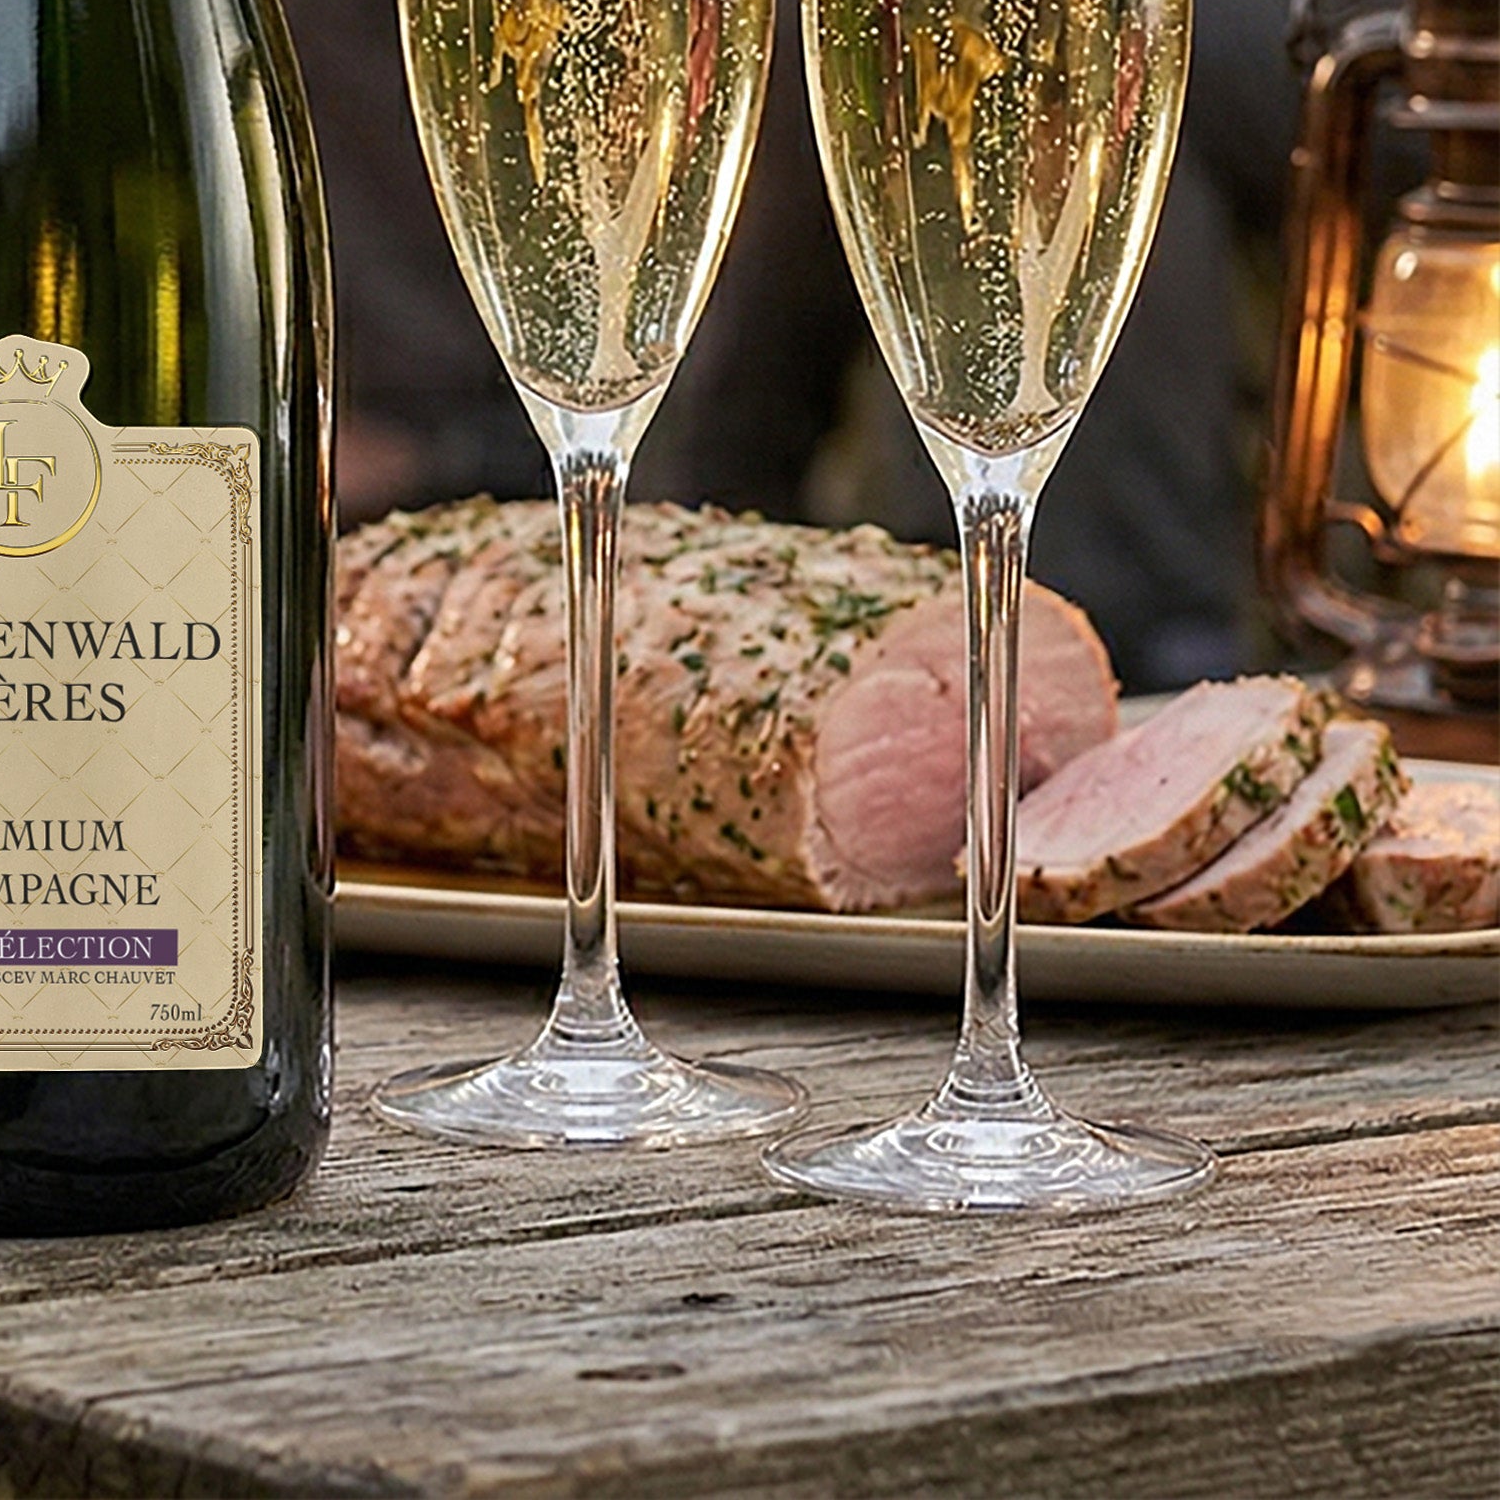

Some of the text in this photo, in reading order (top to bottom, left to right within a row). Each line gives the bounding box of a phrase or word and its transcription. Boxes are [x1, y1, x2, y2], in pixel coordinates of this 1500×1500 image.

[40, 970, 91, 985] MARC
[94, 970, 177, 986] CHAUVET
[150, 1003, 202, 1021] 750ml
